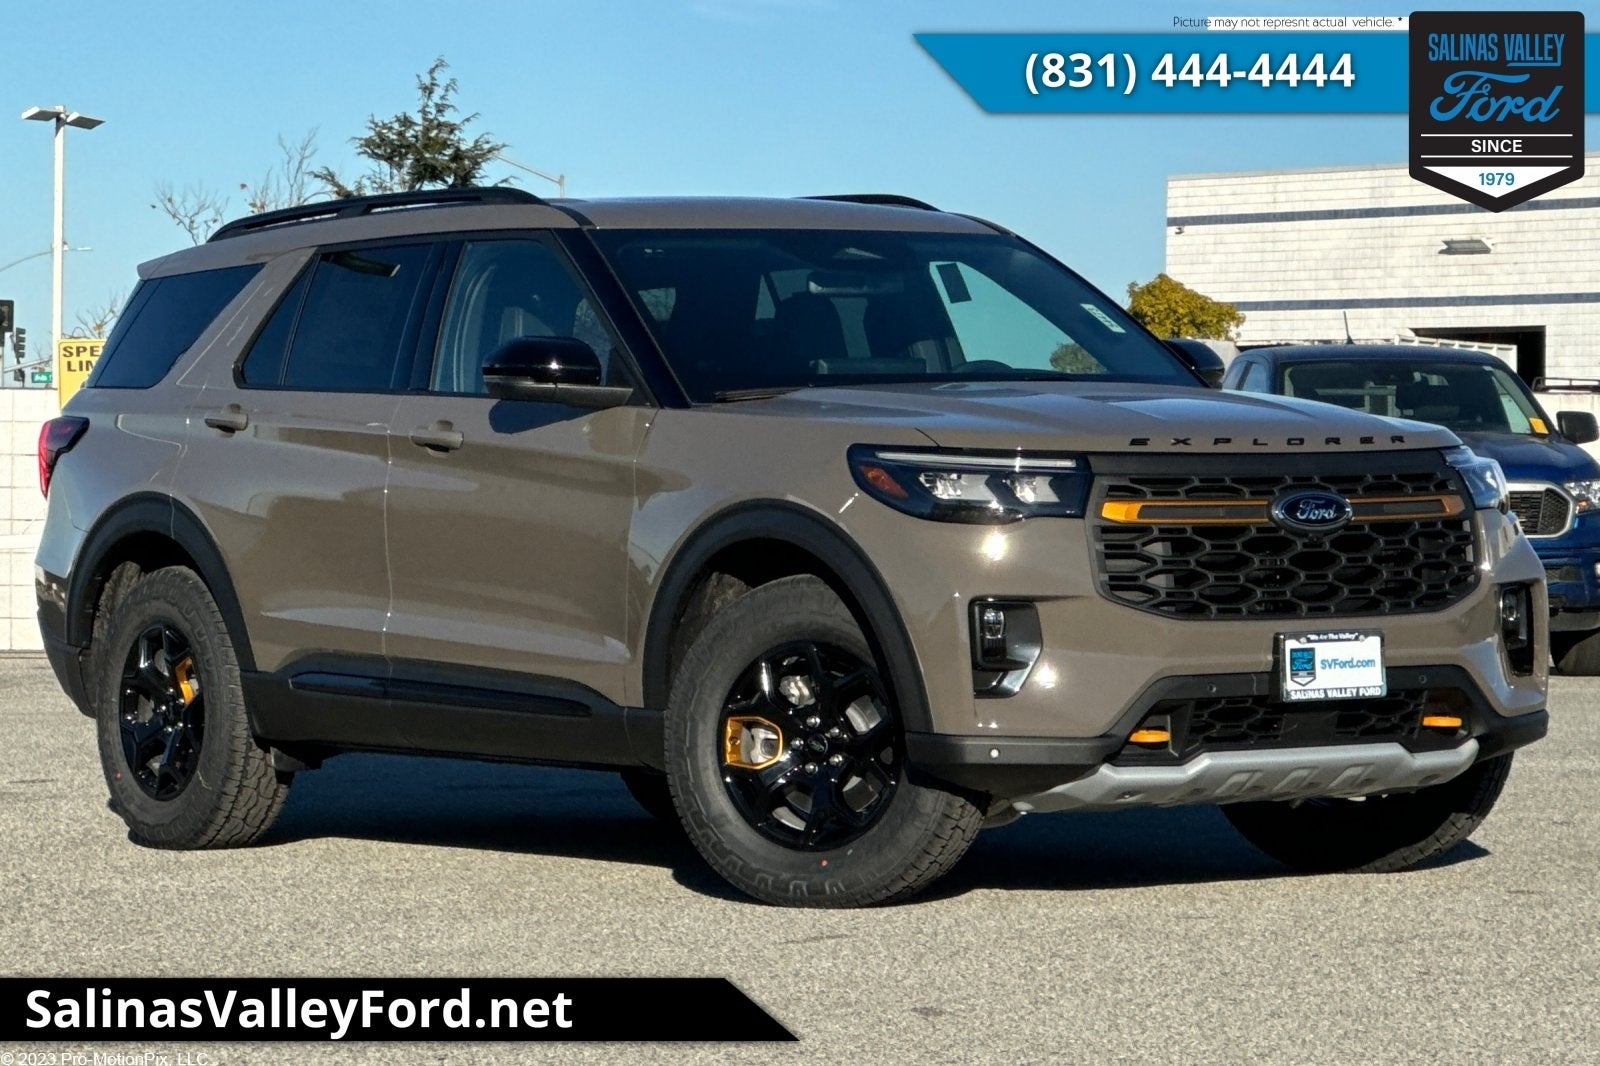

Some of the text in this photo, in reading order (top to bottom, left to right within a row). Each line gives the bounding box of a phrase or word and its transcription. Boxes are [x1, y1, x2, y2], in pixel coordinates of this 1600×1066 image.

[62, 345, 104, 358] SPE
[1128, 435, 1406, 447] EXPLORER
[1296, 499, 1338, 520] Ford
[1320, 657, 1376, 670] SVFord.com
[1290, 686, 1382, 700] SALINAS VALLEY FORD
